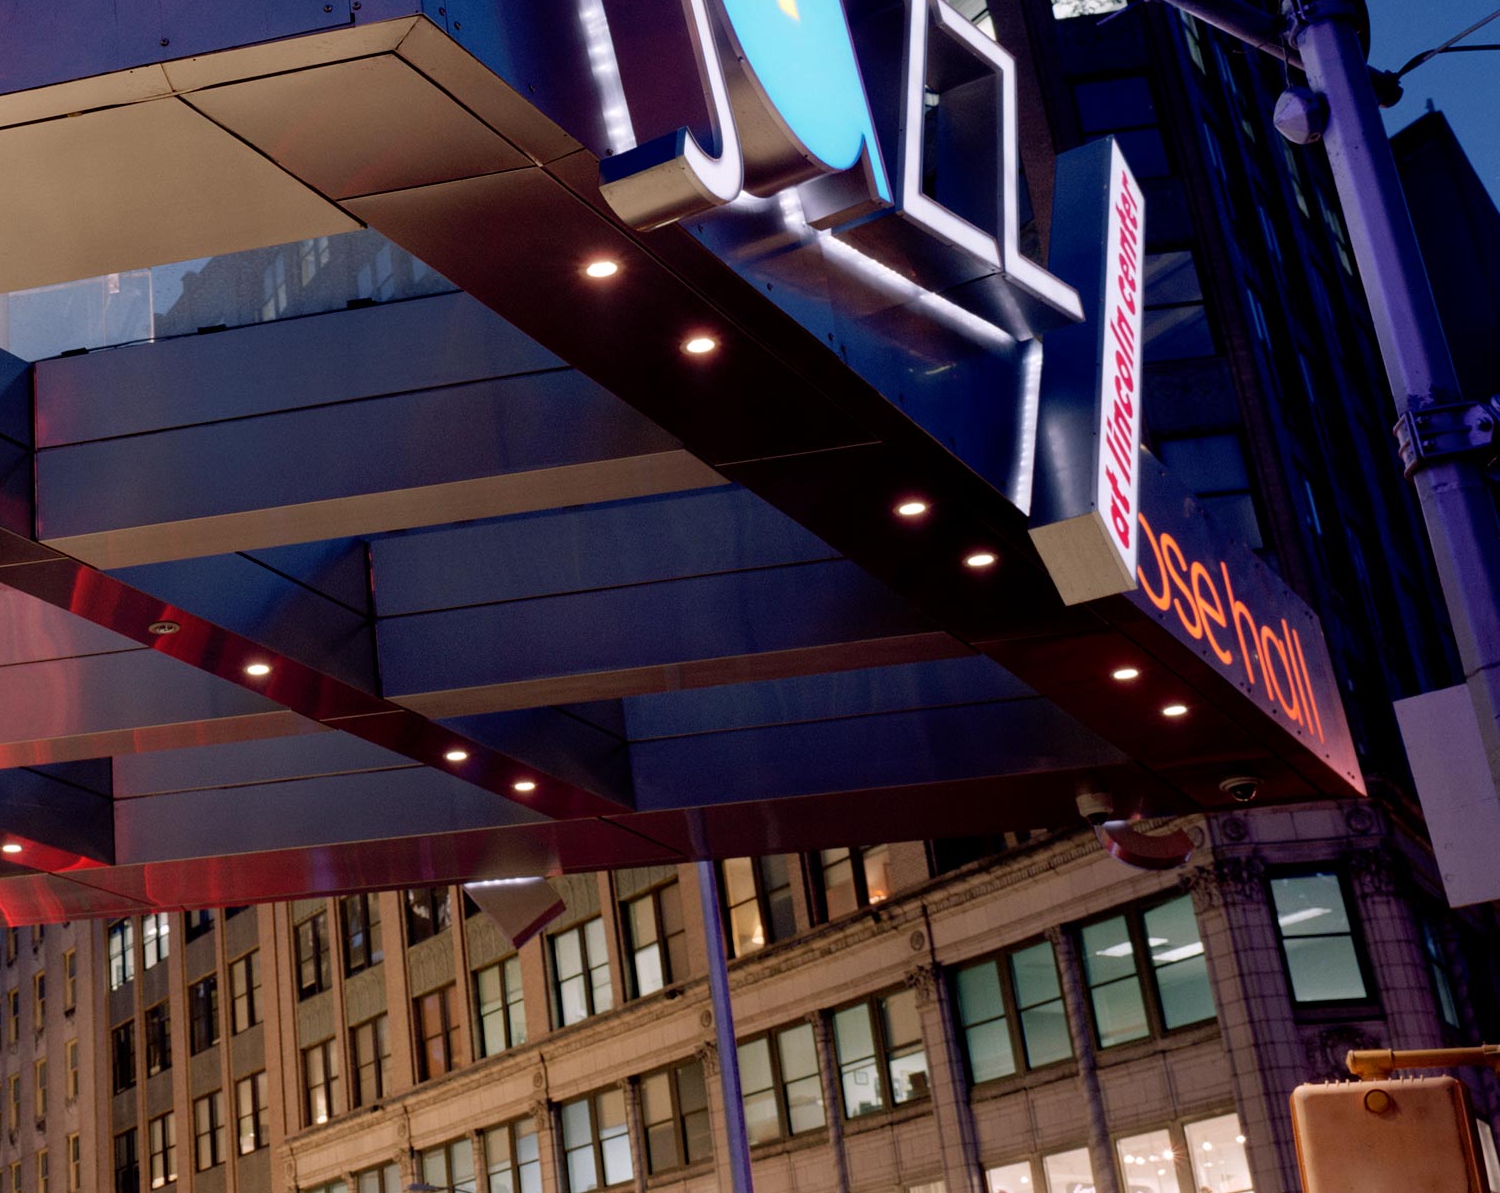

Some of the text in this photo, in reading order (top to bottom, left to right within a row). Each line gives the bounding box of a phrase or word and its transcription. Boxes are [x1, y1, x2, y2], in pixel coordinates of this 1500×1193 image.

[1105, 170, 1139, 550] at lincoln center
[1220, 561, 1325, 744] hall
